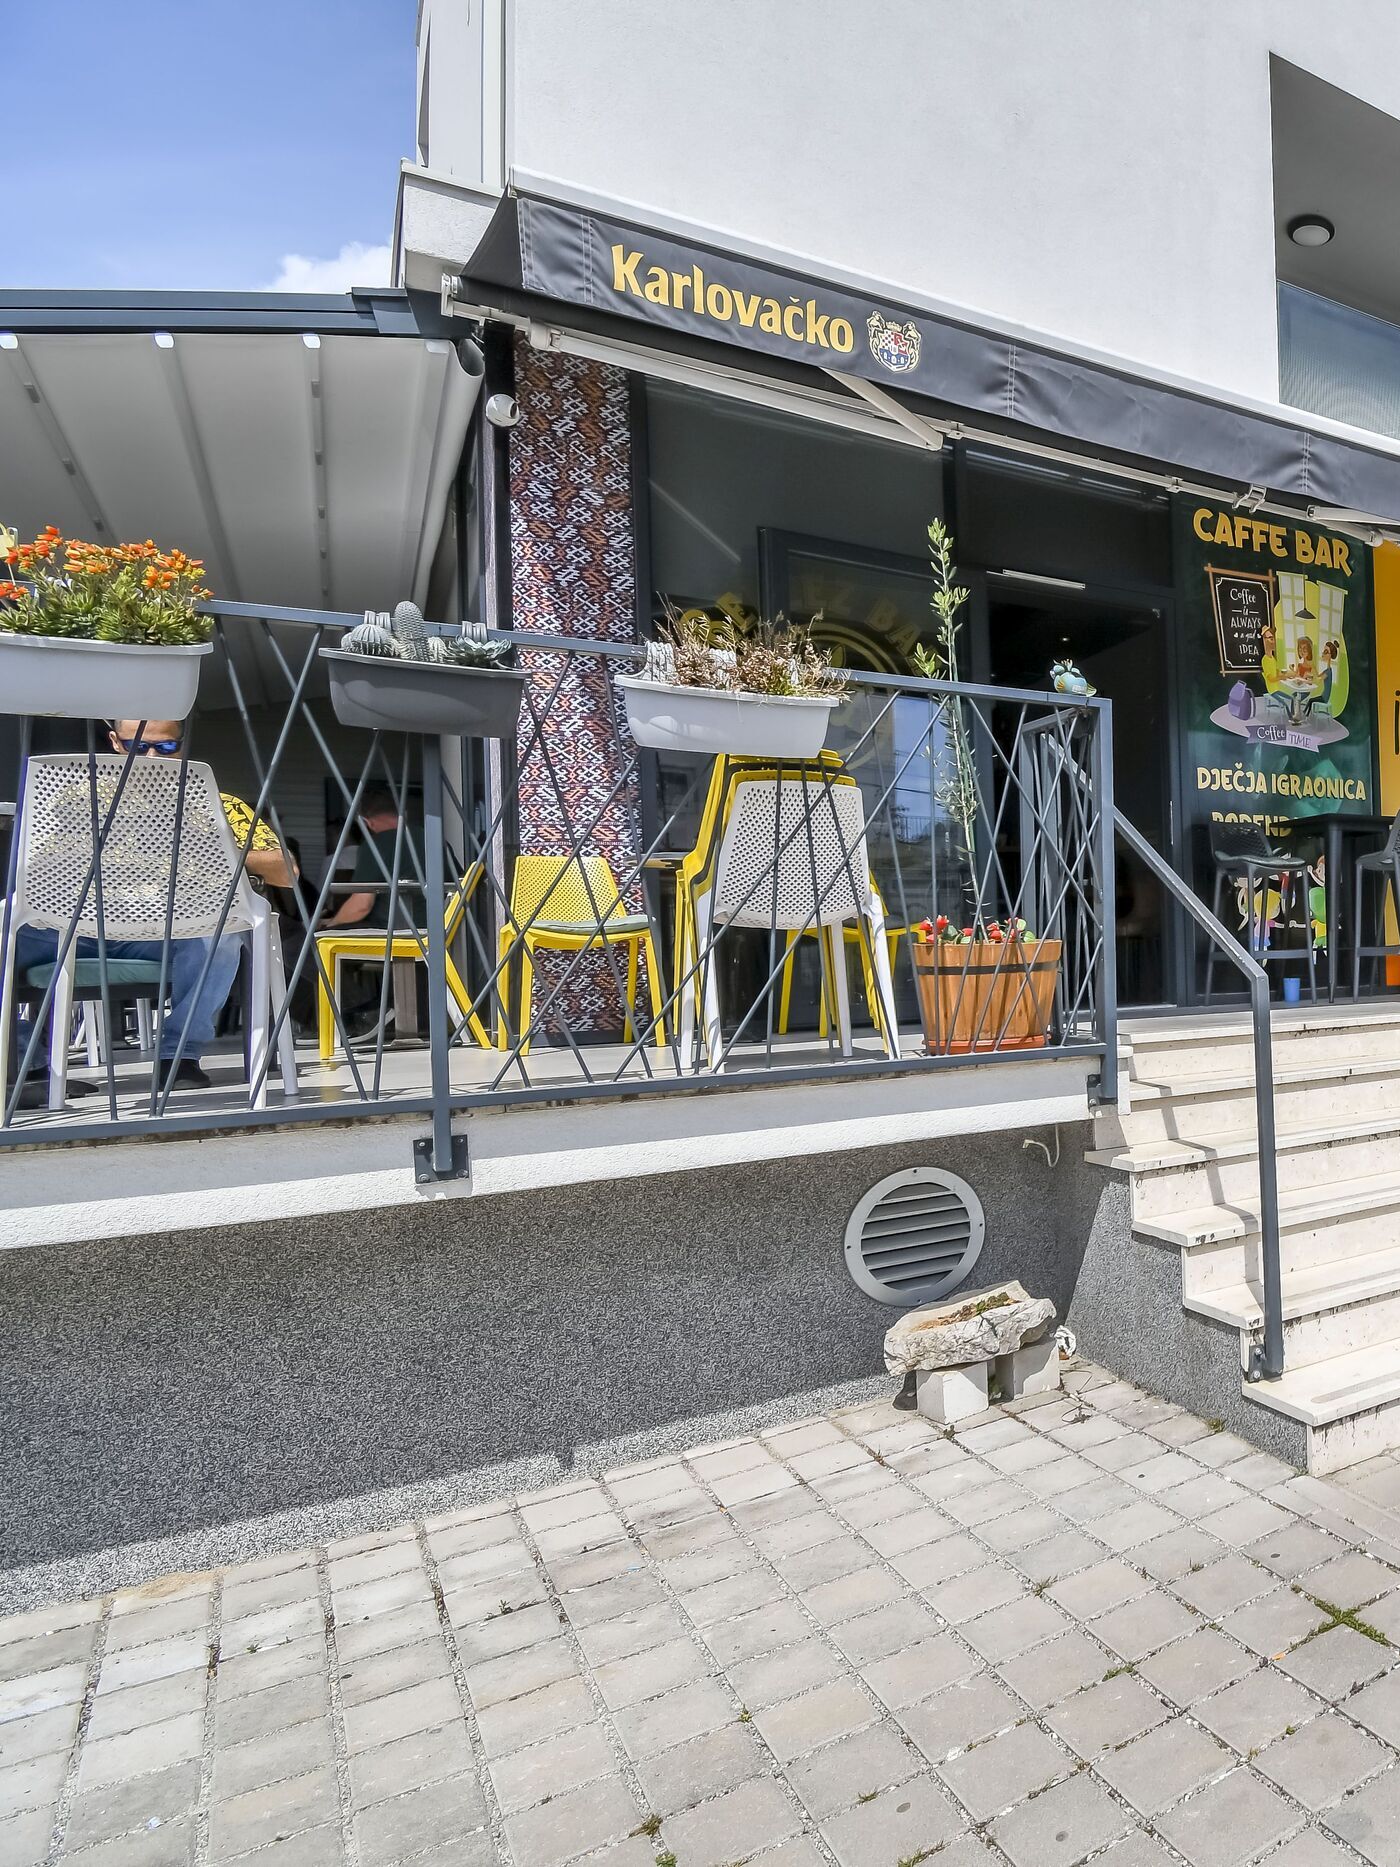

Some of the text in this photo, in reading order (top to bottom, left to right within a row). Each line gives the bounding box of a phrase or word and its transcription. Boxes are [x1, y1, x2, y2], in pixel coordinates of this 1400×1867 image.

[610, 243, 856, 355] Karlovačko
[1192, 508, 1353, 577] CAFFE BAR
[1230, 588, 1257, 605] Coffee
[1230, 616, 1262, 629] ALWAYS
[1239, 643, 1260, 656] IDEA
[1256, 725, 1312, 749] Coffee TIME
[1196, 762, 1367, 801] DJEČJA IGRAONICA
